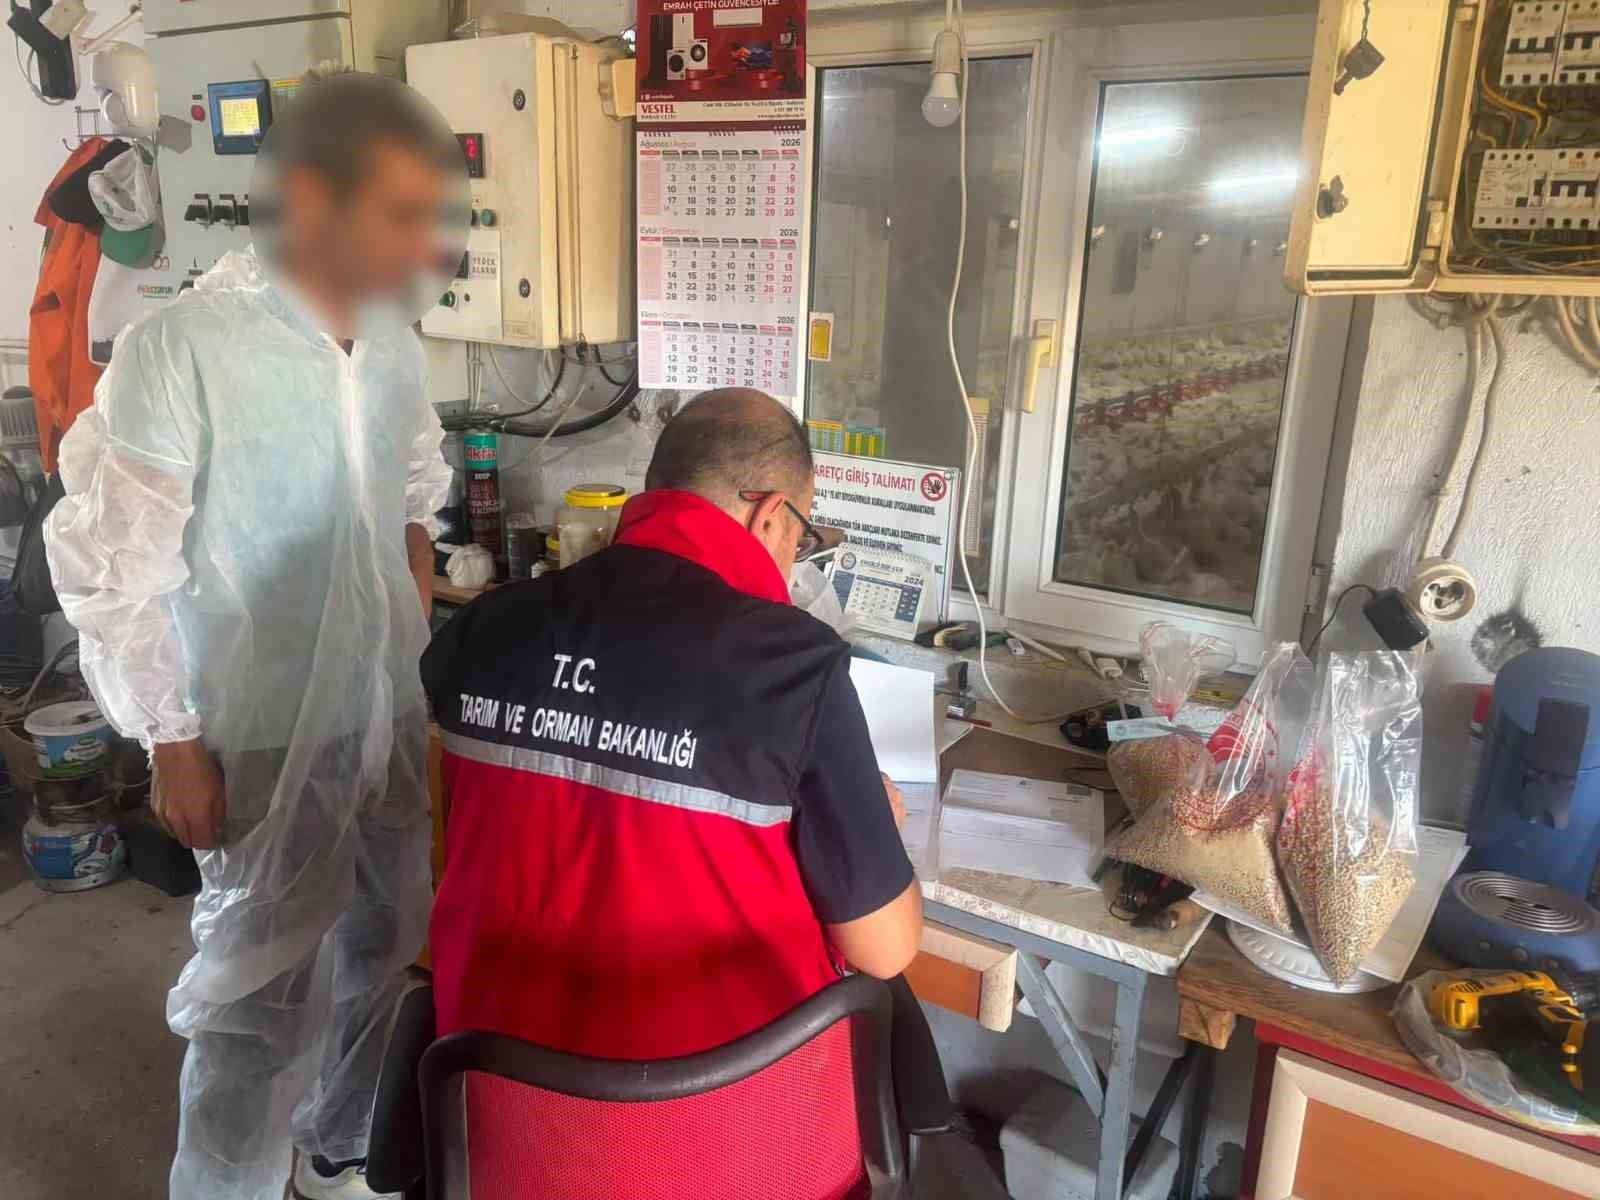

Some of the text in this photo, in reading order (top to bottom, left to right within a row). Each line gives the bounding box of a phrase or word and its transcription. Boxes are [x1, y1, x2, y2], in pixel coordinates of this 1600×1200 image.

[641, 104, 677, 113] VESTEL
[667, 186, 677, 194] 10
[689, 186, 696, 194] 11
[708, 186, 716, 194] 12
[728, 186, 735, 194] 13
[747, 186, 755, 194] 14
[668, 197, 677, 205] 17
[688, 197, 696, 205] 18
[726, 197, 736, 205] 20
[686, 208, 696, 216] 25
[726, 208, 735, 216] 27
[780, 229, 798, 237] 2026
[766, 263, 774, 271] 12
[667, 282, 677, 290] 21
[706, 283, 716, 291] 23
[686, 293, 697, 301] 29
[689, 355, 697, 363] 13
[727, 357, 735, 365] 15
[765, 360, 772, 368] 17
[667, 365, 677, 373] 19
[708, 366, 717, 374] 21
[687, 376, 697, 384] 27
[744, 379, 753, 387] 30
[814, 463, 916, 492] ARETÇİ GİRİŞ TALİMATI
[552, 653, 596, 694] T.C.
[460, 693, 697, 769] TARIM VE ORMAN BAKANLIĞI
